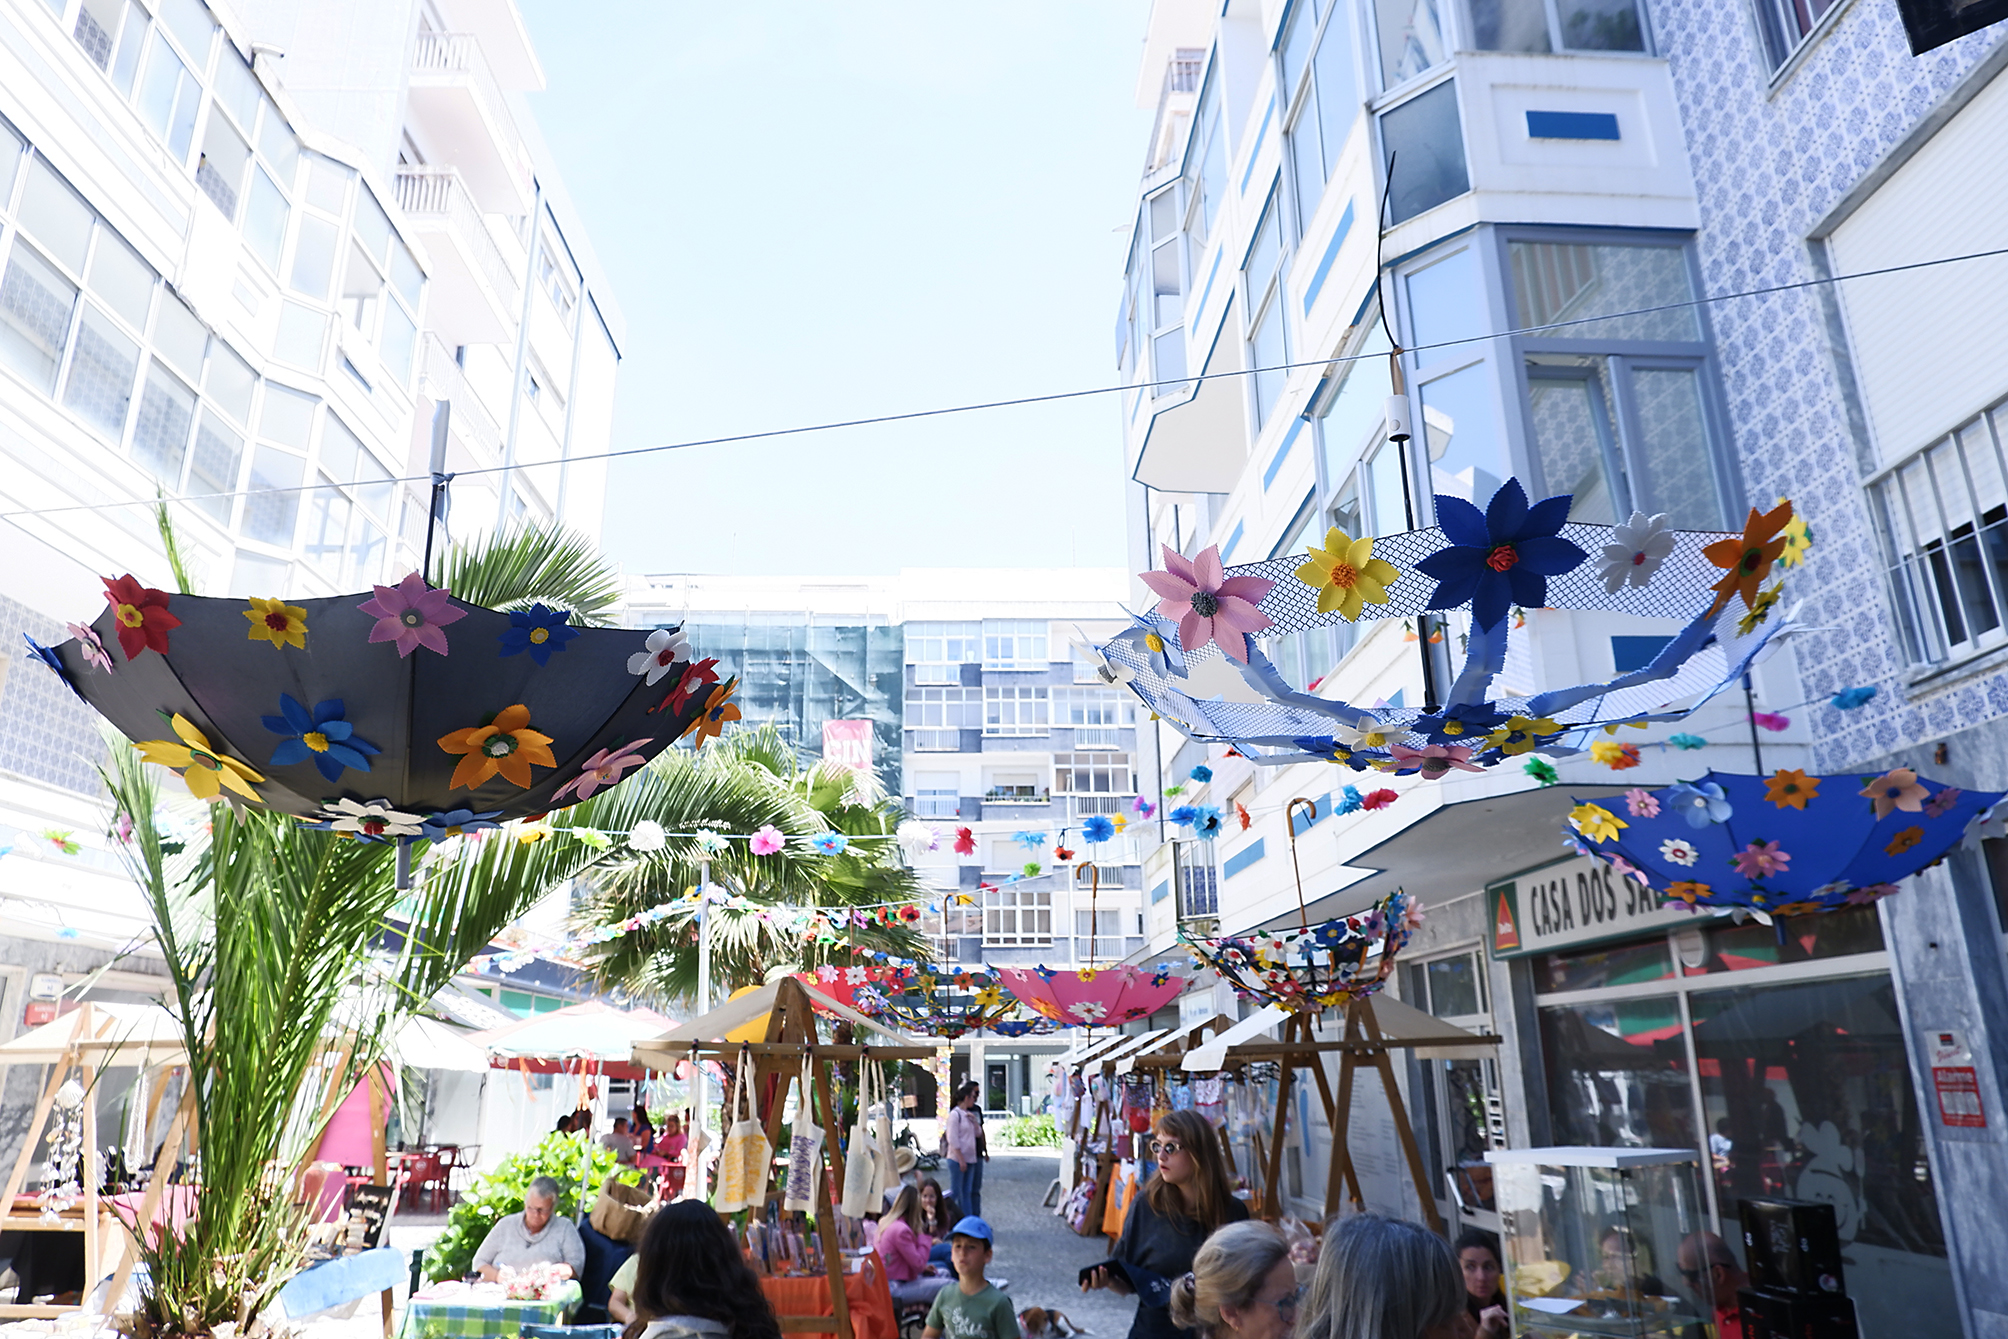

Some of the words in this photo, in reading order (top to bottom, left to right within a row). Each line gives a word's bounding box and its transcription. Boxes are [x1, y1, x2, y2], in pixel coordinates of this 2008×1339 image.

[1531, 877, 1574, 937] CASA
[1577, 864, 1616, 926] DOS
[1936, 1070, 1974, 1083] Alarme
